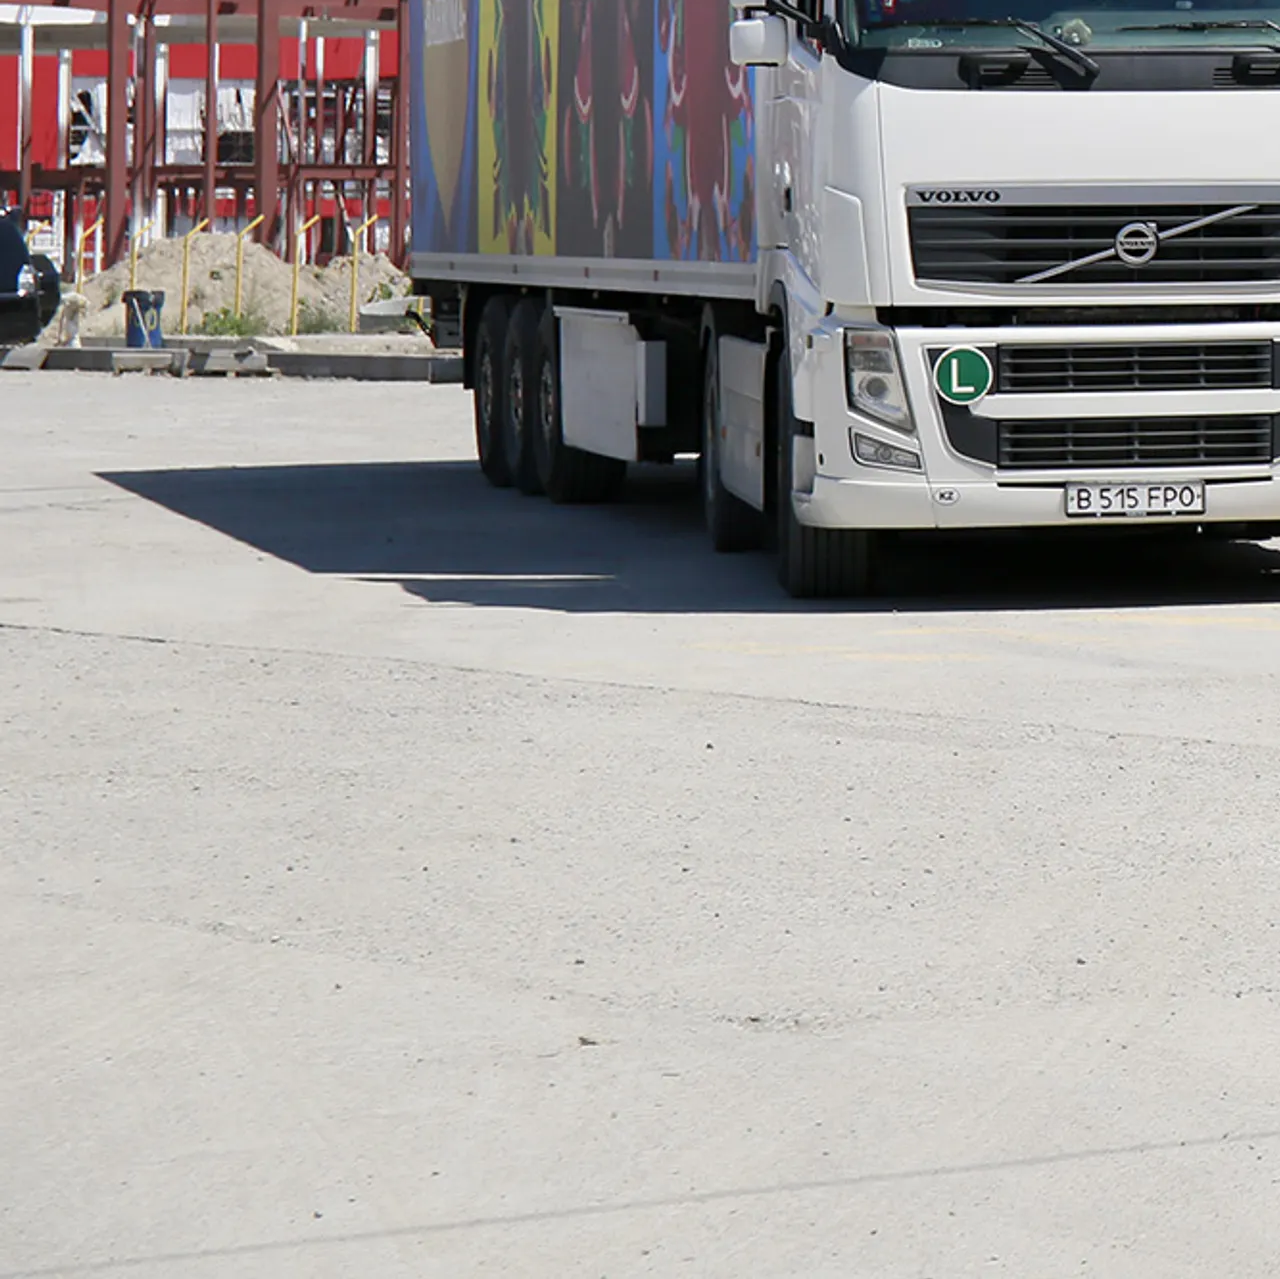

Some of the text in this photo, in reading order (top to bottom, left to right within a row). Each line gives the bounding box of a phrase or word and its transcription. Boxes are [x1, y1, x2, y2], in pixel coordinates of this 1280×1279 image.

[916, 190, 1001, 203] VOLVO
[951, 358, 975, 393] L
[938, 490, 954, 501] KZ
[1077, 485, 1195, 510] B 515 FPO
